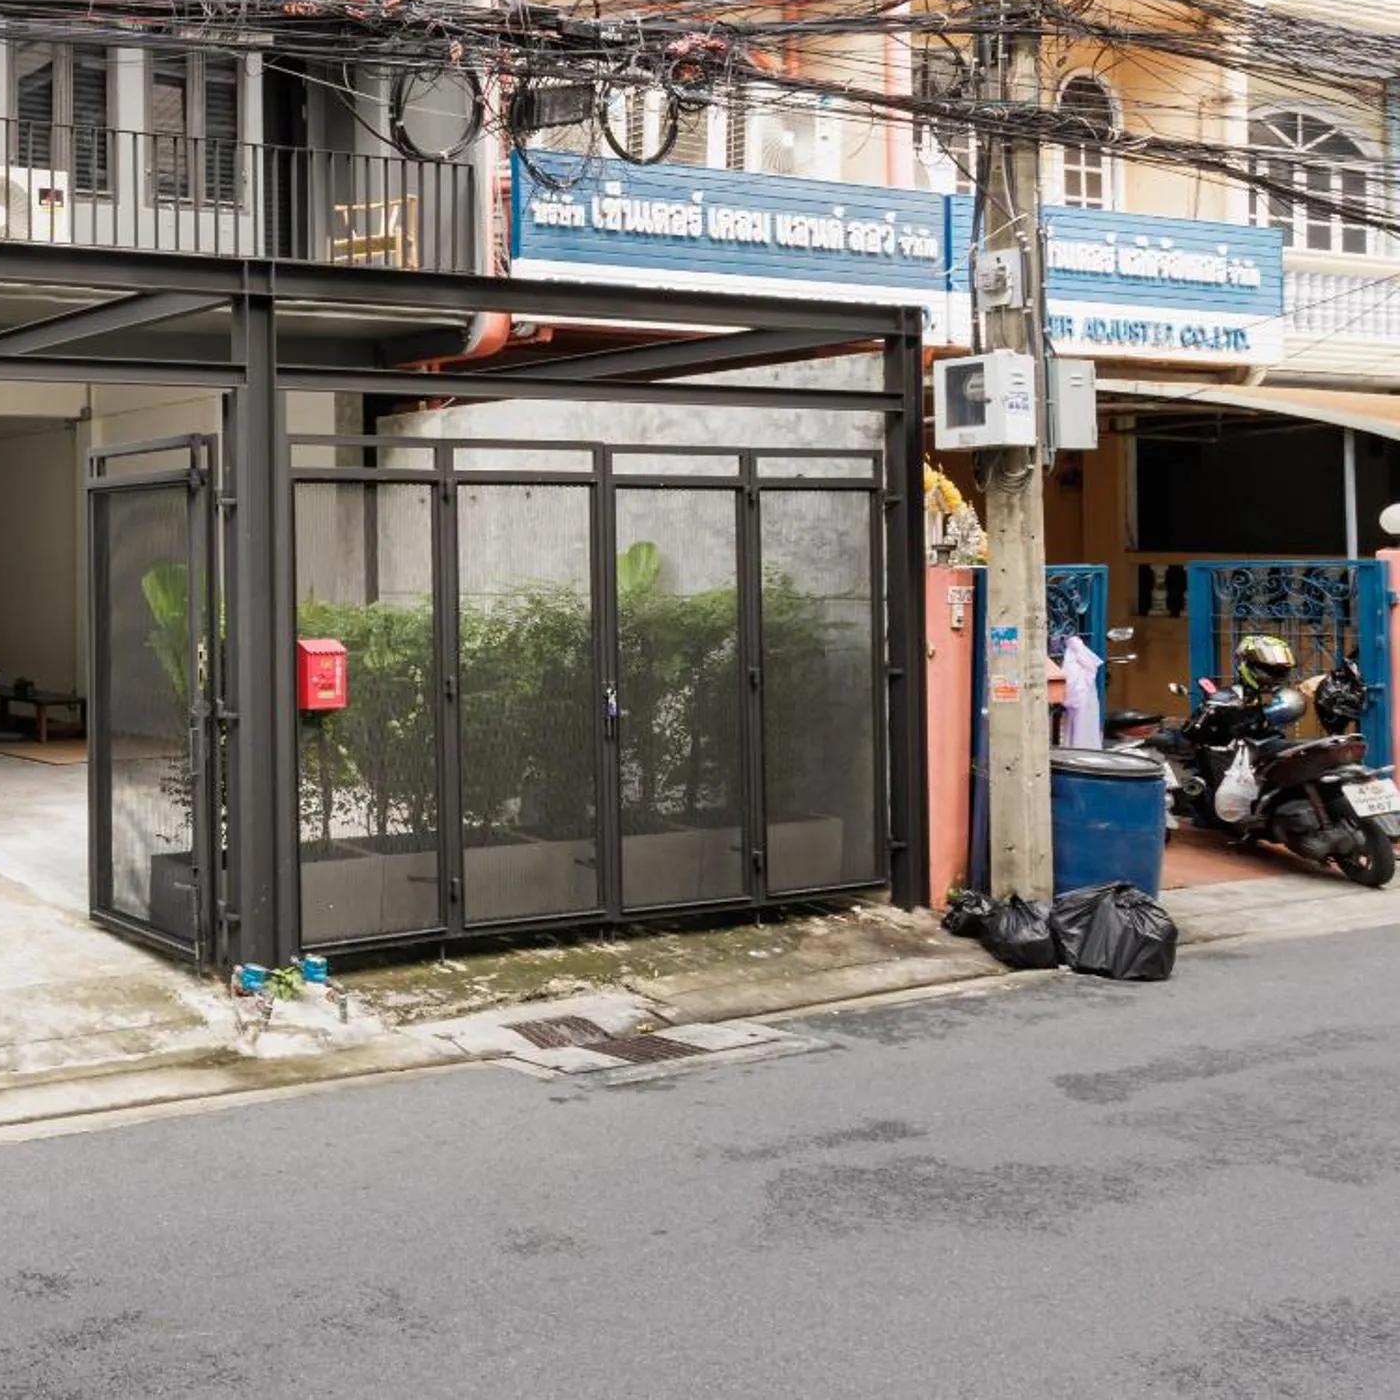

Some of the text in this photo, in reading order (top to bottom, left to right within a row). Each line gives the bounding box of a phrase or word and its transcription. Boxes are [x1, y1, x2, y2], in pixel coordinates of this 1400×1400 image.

[707, 207, 771, 244] เคลม
[775, 206, 845, 251] แอนด์
[847, 211, 896, 254] ลอว์
